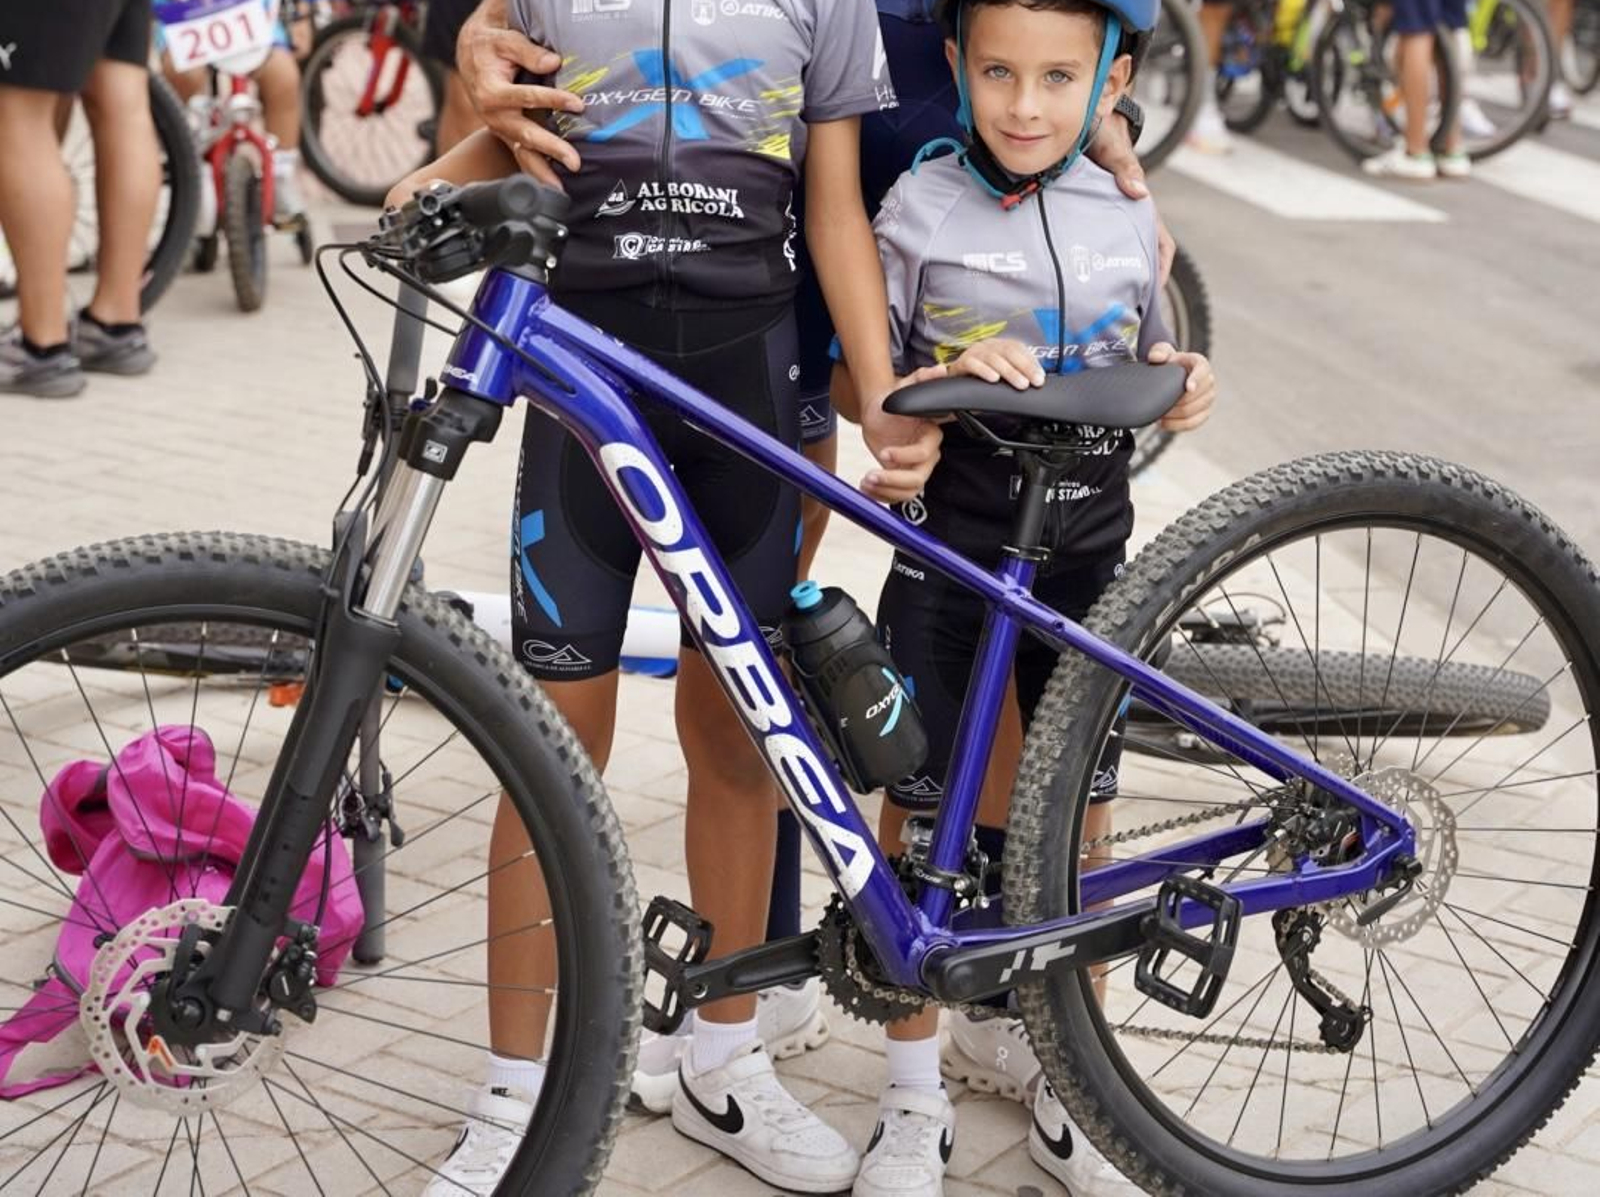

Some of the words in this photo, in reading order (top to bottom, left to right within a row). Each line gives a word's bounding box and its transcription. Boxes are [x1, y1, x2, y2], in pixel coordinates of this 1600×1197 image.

[180, 12, 255, 60] 201
[699, 93, 759, 113] BIKE
[636, 181, 739, 205] ALBORANI
[640, 197, 745, 219] AGRICOLA
[600, 441, 876, 900] ORBEA
